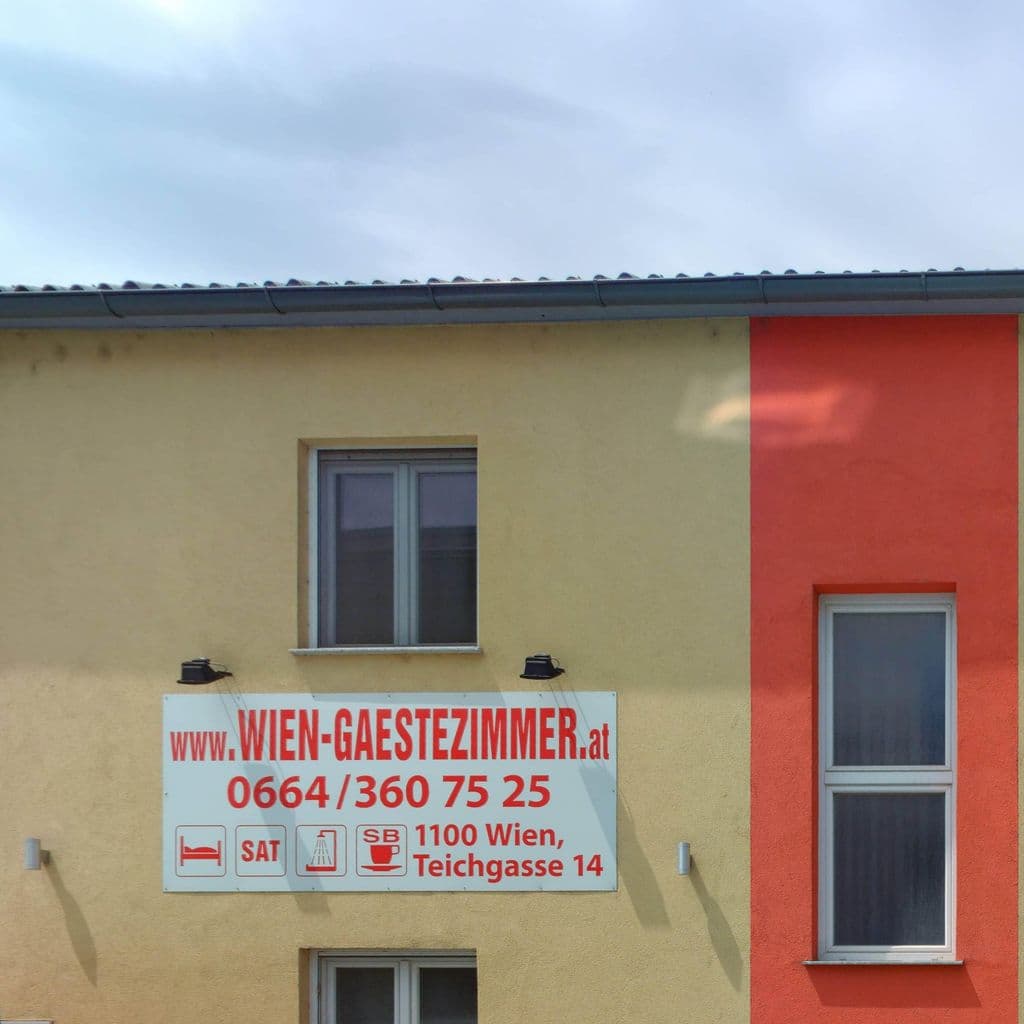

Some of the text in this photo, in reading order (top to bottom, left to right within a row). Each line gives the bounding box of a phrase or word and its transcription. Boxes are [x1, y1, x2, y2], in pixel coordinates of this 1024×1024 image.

[170, 707, 609, 762] www.WIEN-GAESTEZIMMER.at
[442, 774, 489, 809] 75
[502, 774, 552, 809] 25
[363, 828, 400, 843] SB
[415, 822, 564, 849] 1100 Wien,
[241, 839, 281, 863] SAT
[413, 853, 604, 884] Teichgasse 14
